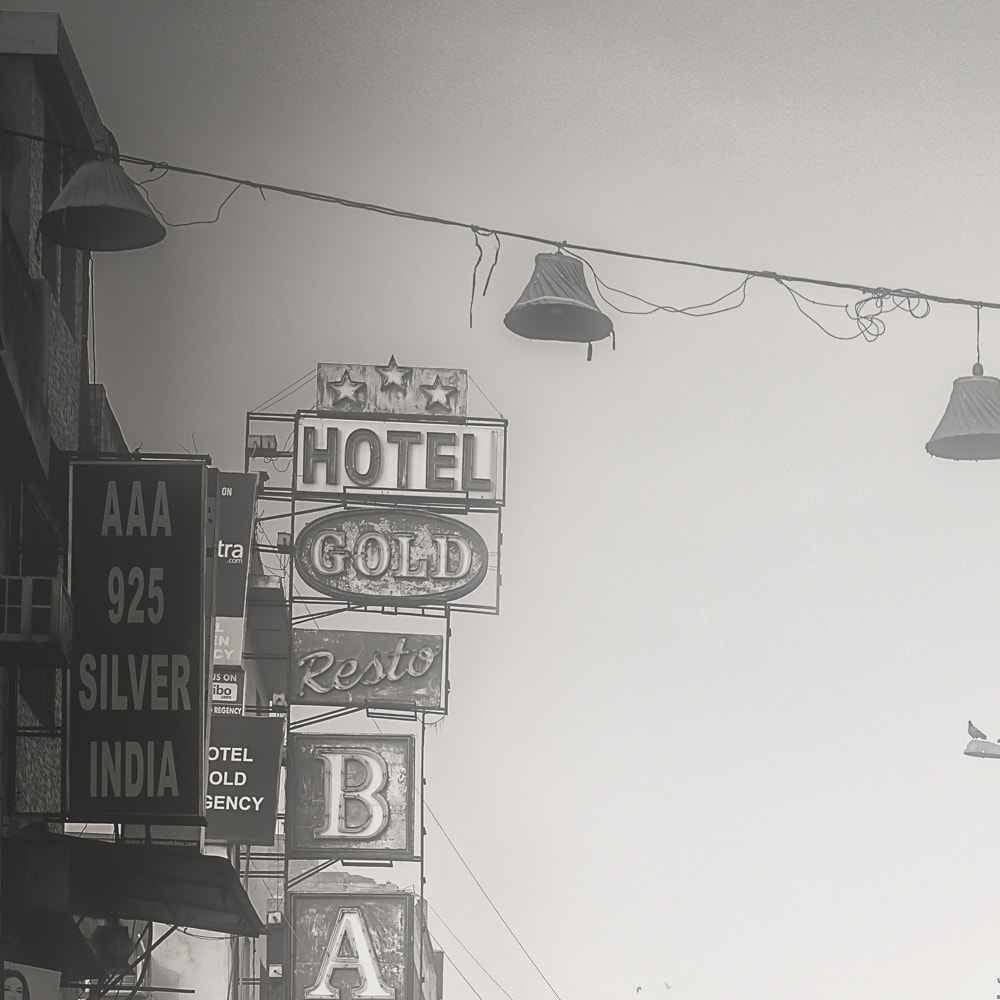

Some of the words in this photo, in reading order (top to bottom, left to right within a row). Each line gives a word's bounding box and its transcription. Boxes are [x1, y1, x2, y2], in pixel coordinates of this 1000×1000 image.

[302, 426, 491, 491] HOTEL
[100, 480, 173, 537] AAA
[310, 529, 473, 580] GOLD
[107, 566, 165, 625] 925
[78, 653, 192, 712] SILVER
[299, 637, 440, 698] Resto
[213, 706, 242, 715] REGENCY
[90, 740, 180, 798] INDIA
[208, 746, 254, 762] OTEL
[208, 770, 248, 786] OLD
